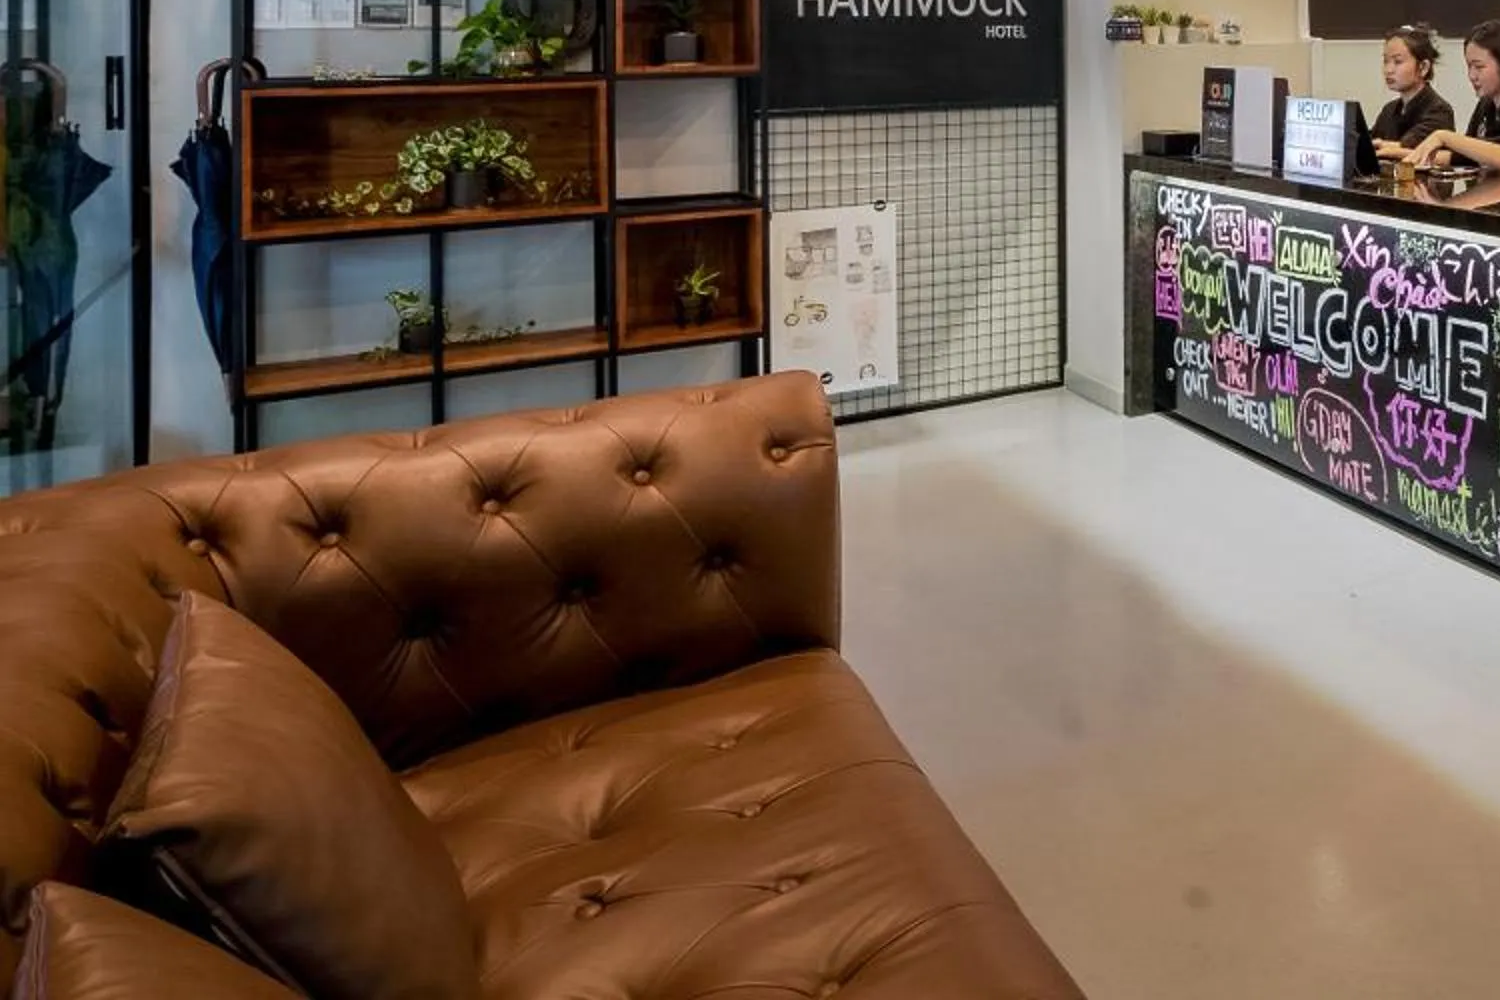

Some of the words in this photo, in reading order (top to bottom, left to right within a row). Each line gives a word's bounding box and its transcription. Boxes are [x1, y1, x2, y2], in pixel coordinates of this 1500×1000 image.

[985, 25, 1027, 39] HOTEL
[1157, 186, 1203, 216] CHECK
[1175, 216, 1192, 241] IN
[1341, 223, 1391, 268] Xin
[1280, 237, 1333, 276] ALOHA
[1173, 336, 1213, 370] CHECK
[1222, 262, 1488, 420] WELCOME
[1183, 370, 1210, 400] OUT
[1385, 391, 1457, 467] 你好
[1328, 455, 1377, 502] MATE
